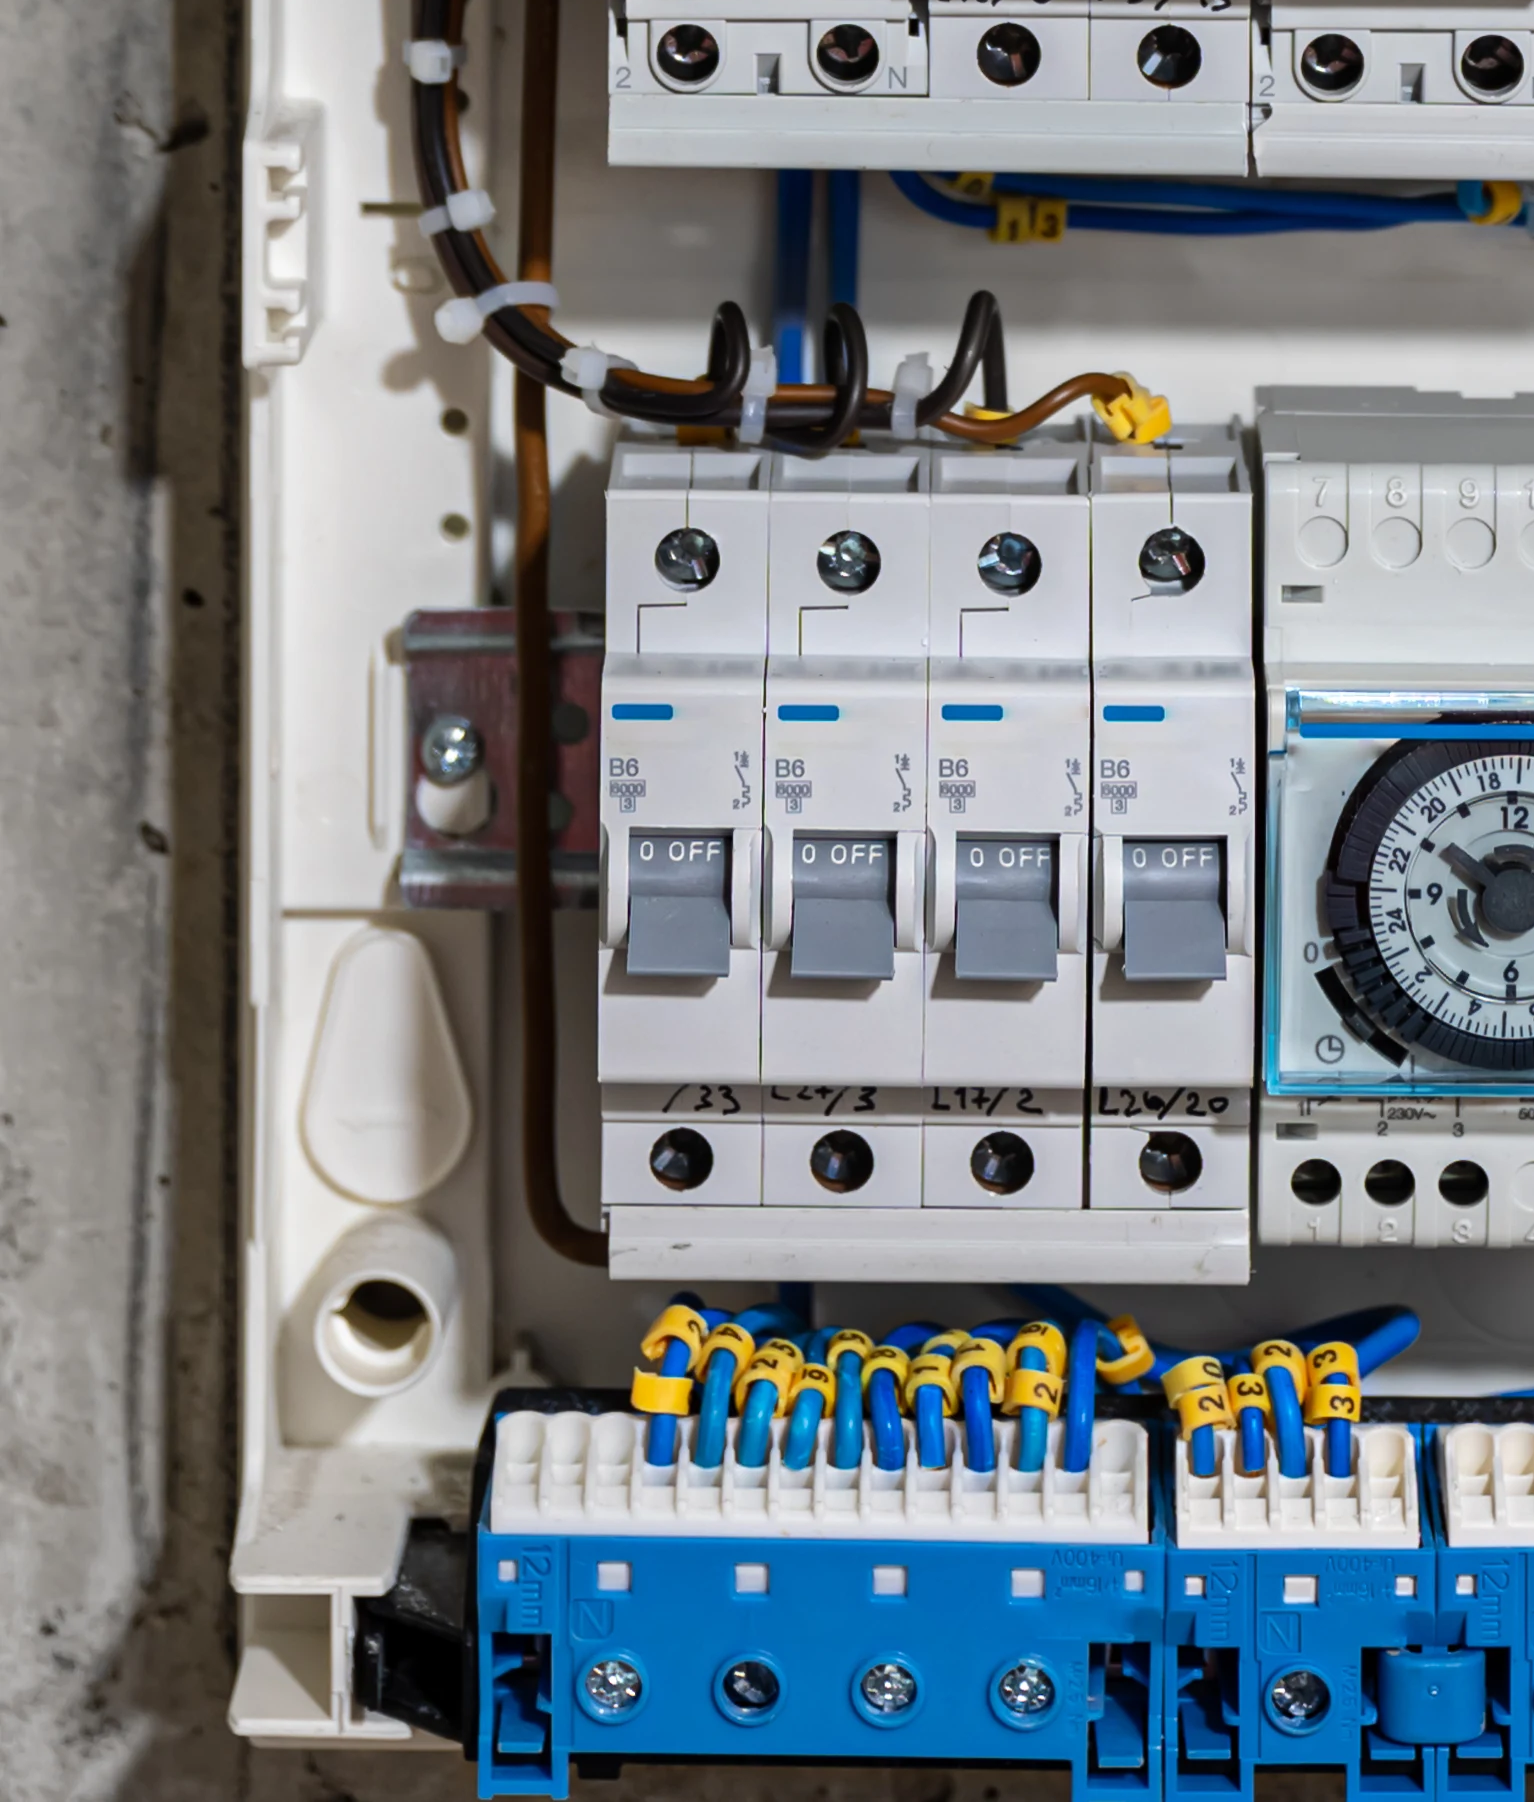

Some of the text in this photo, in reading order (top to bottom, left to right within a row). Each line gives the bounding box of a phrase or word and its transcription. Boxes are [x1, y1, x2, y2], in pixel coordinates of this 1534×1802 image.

[615, 66, 632, 89] 2
[888, 66, 908, 89] N
[1259, 76, 1275, 98] 2
[1311, 477, 1335, 508] 7
[1384, 477, 1409, 509] 8
[1457, 478, 1481, 509] 9
[609, 758, 640, 778] B6
[775, 758, 806, 779] B6
[938, 758, 969, 778] B6
[1100, 759, 1131, 779] B6
[1476, 773, 1502, 792] 18
[1420, 798, 1448, 824] 20
[1500, 806, 1529, 831] 12
[668, 841, 722, 861] OFF
[830, 844, 883, 865] OFF
[998, 847, 1051, 868] OFF
[1161, 847, 1214, 868] OFF
[1388, 846, 1412, 874] 22
[1426, 883, 1443, 906] 9
[1388, 907, 1407, 935] 24
[1503, 960, 1519, 983] 6
[520, 1544, 553, 1629] 12mm
